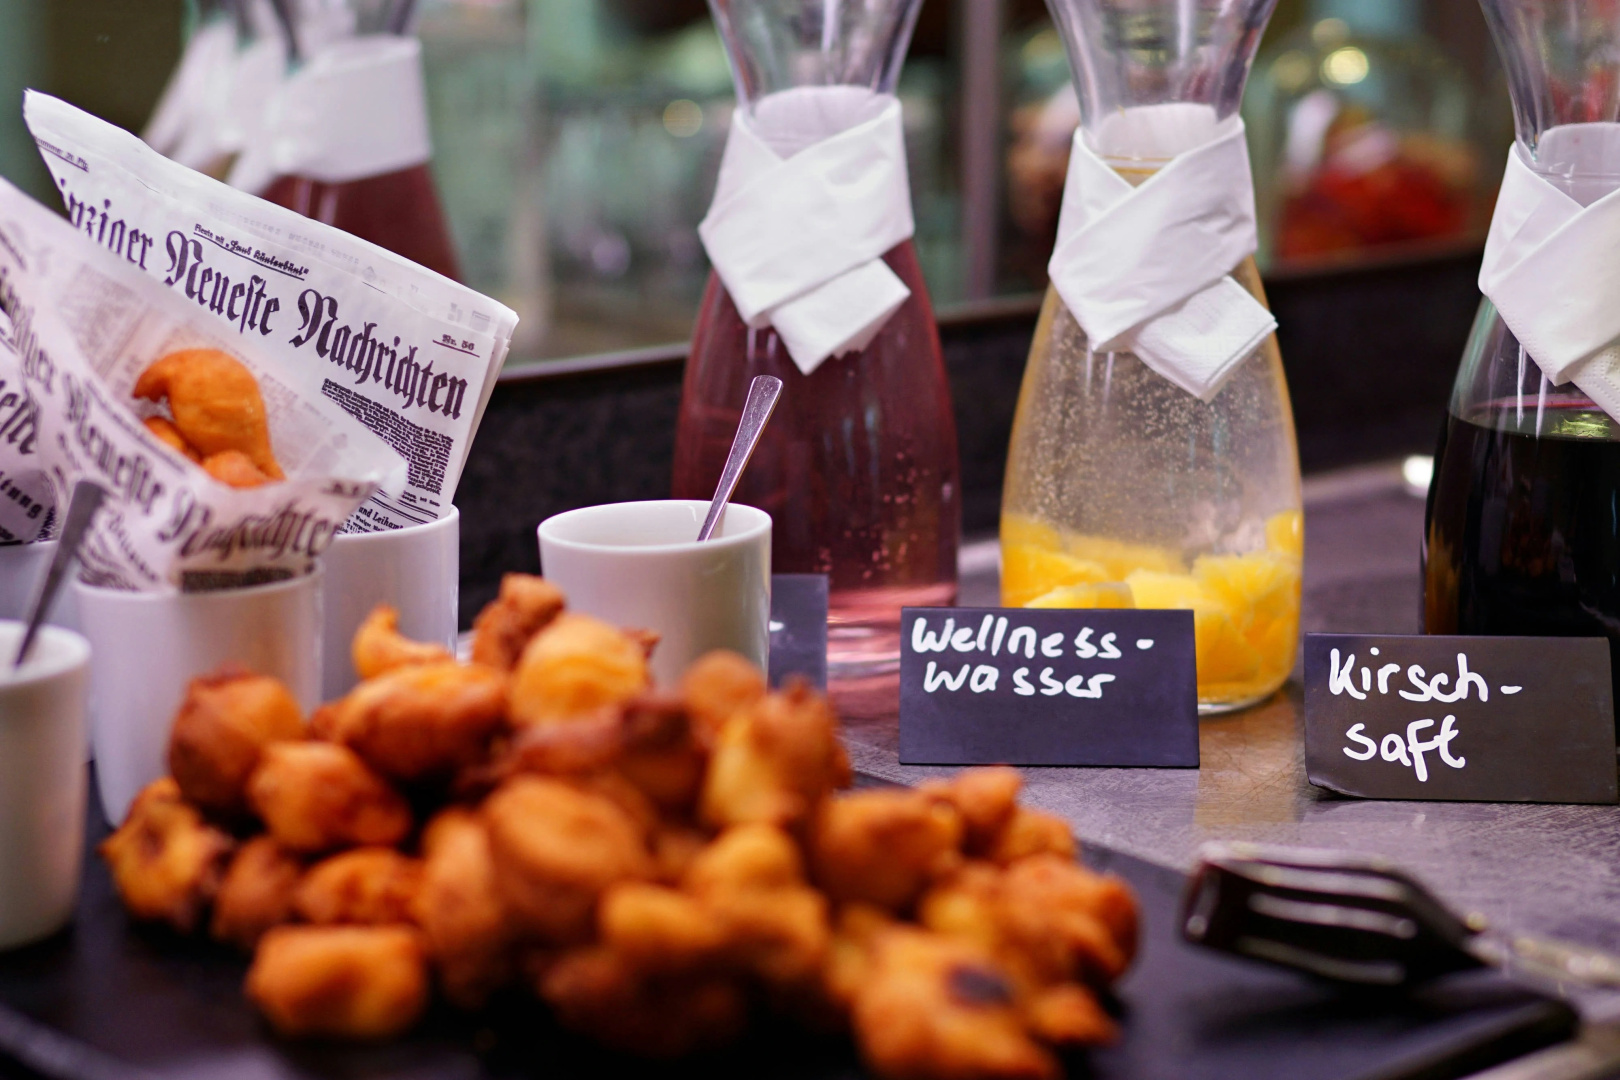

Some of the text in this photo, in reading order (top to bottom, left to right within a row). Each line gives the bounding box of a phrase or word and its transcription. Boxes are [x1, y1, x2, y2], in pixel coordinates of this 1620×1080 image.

[288, 288, 468, 420] Nachrichten
[911, 614, 1154, 659] Wellness-
[1328, 647, 1523, 703] Kirsch-
